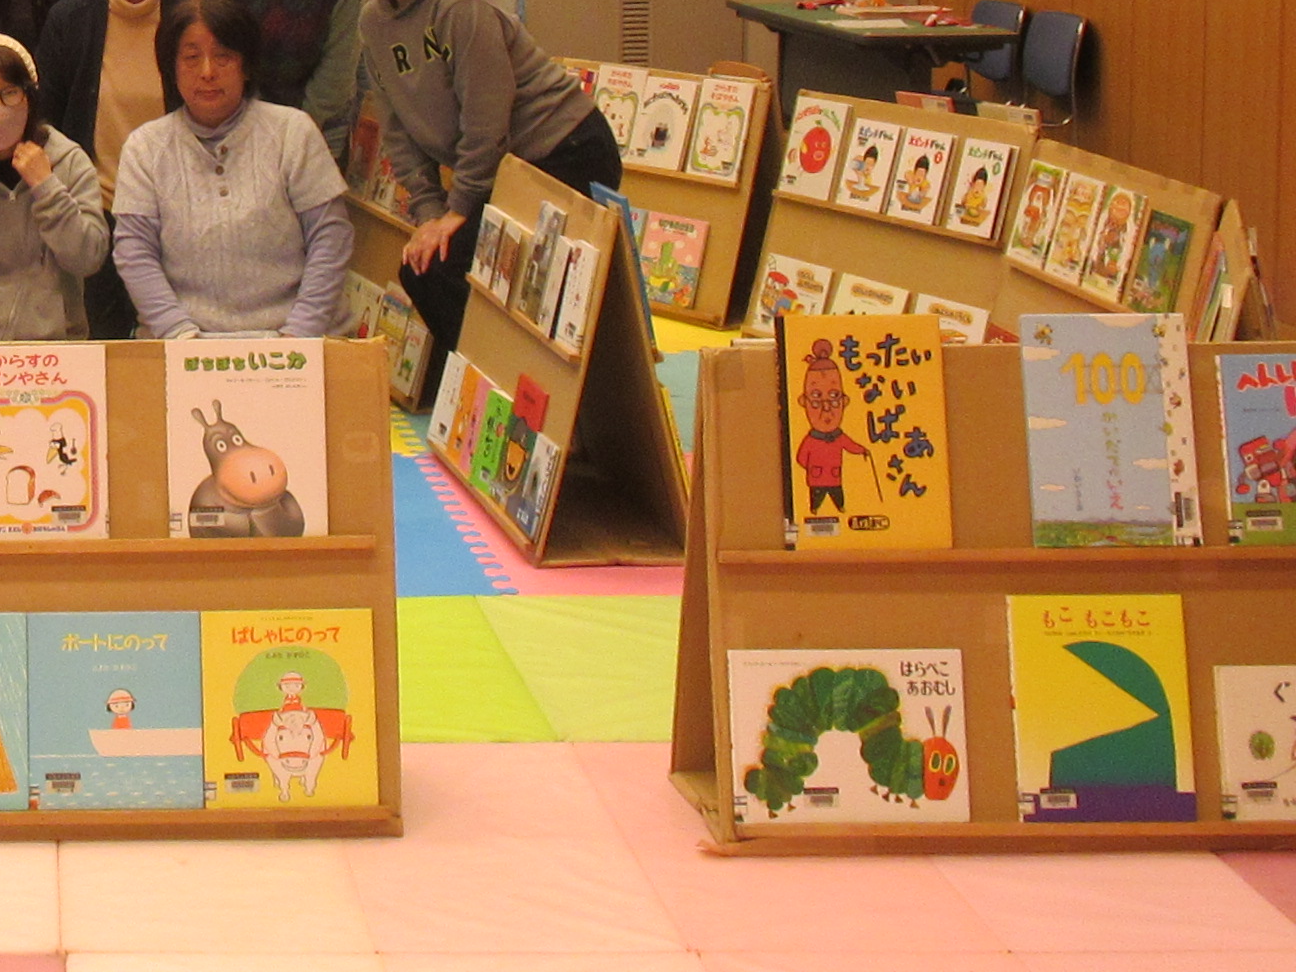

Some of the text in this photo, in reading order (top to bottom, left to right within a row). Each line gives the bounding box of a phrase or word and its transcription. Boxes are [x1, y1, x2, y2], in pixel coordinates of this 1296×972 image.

[839, 334, 933, 370] もったい
[855, 373, 917, 404] ない
[1060, 352, 1146, 406] 100
[886, 454, 927, 497] さん
[1043, 606, 1150, 629] もこ もこもこ
[61, 633, 169, 652] ボートにのって
[231, 626, 341, 645] ばしゃにのって
[900, 660, 950, 678] はらぺこ
[906, 680, 956, 697] あおむし
